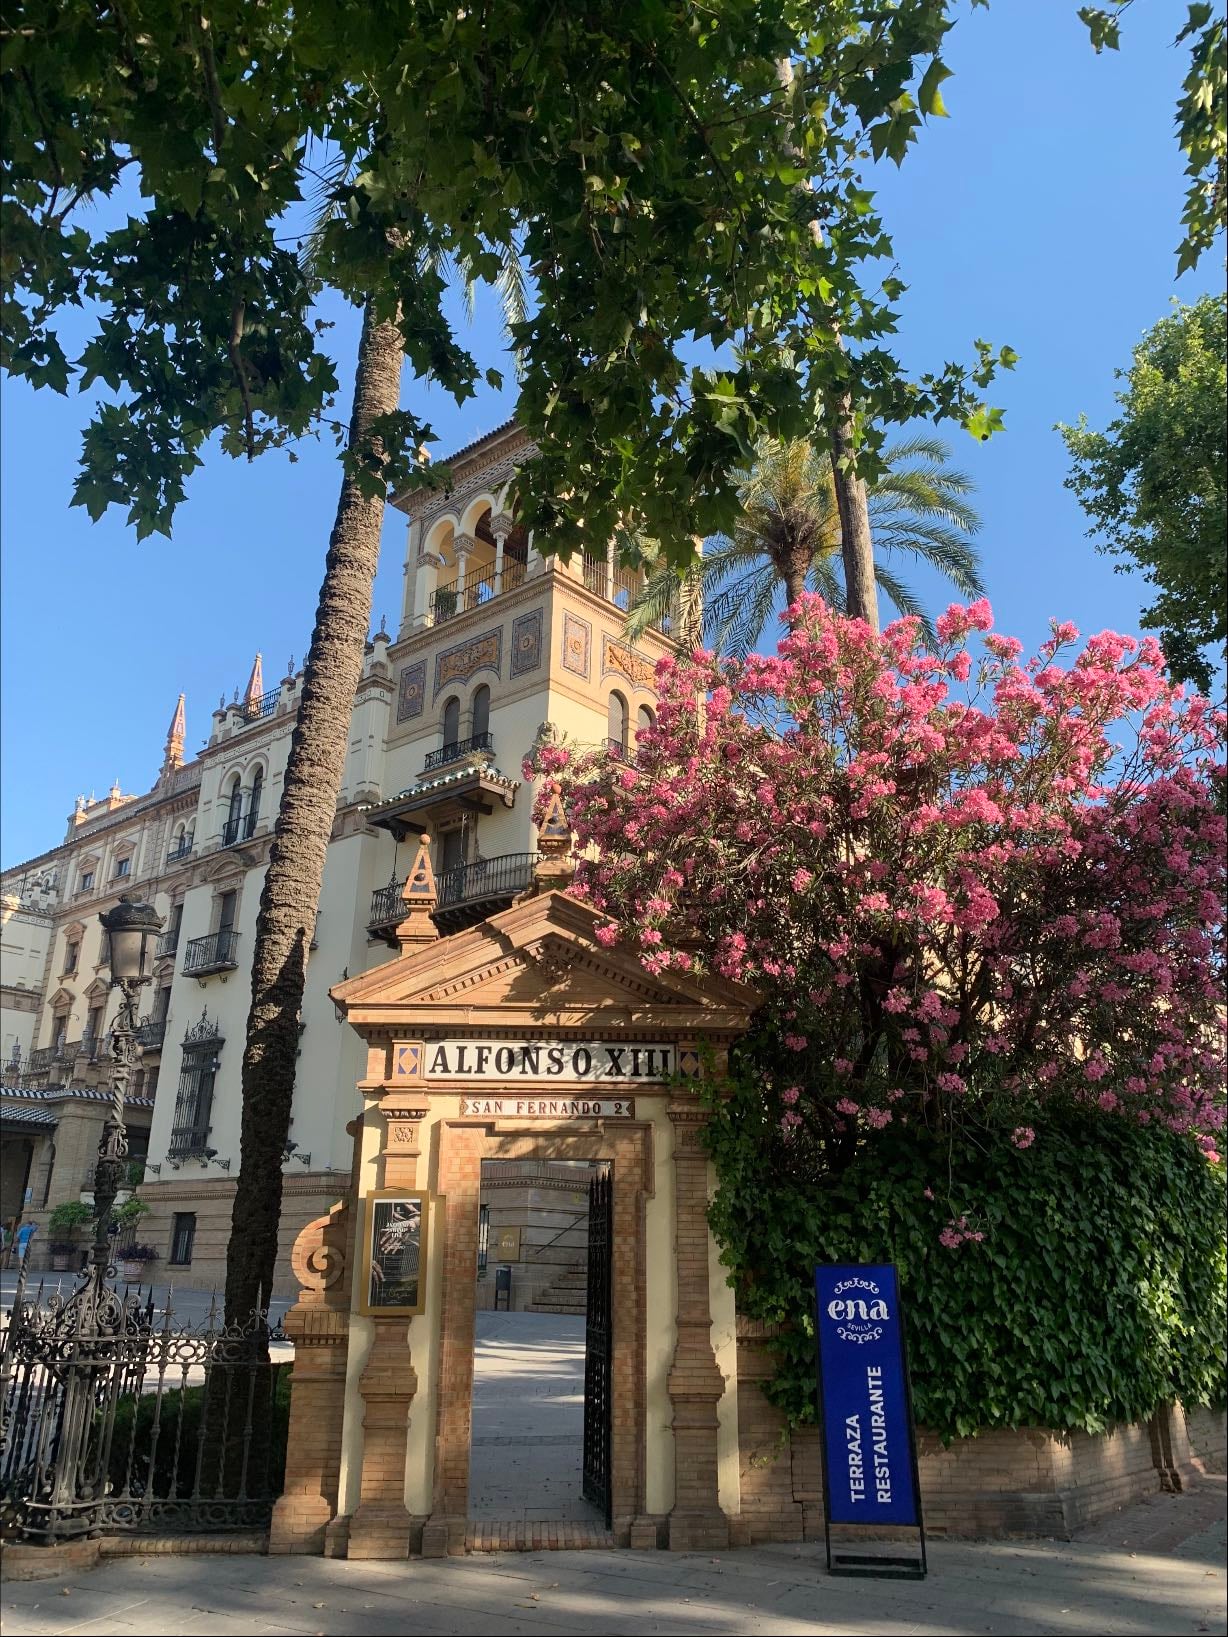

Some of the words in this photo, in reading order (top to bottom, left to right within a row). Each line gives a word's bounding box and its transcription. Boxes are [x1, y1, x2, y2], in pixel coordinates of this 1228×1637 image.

[428, 1045, 592, 1077] ALFONSO
[604, 1048, 671, 1077] XIII
[471, 1100, 504, 1115] SAN
[516, 1101, 602, 1116] FERNANDO
[613, 1102, 623, 1115] 2
[827, 1299, 890, 1320] ena
[847, 1322, 873, 1332] SEVILLA
[867, 1366, 891, 1503] RESTAURANTE
[846, 1415, 865, 1502] TERRAZA
